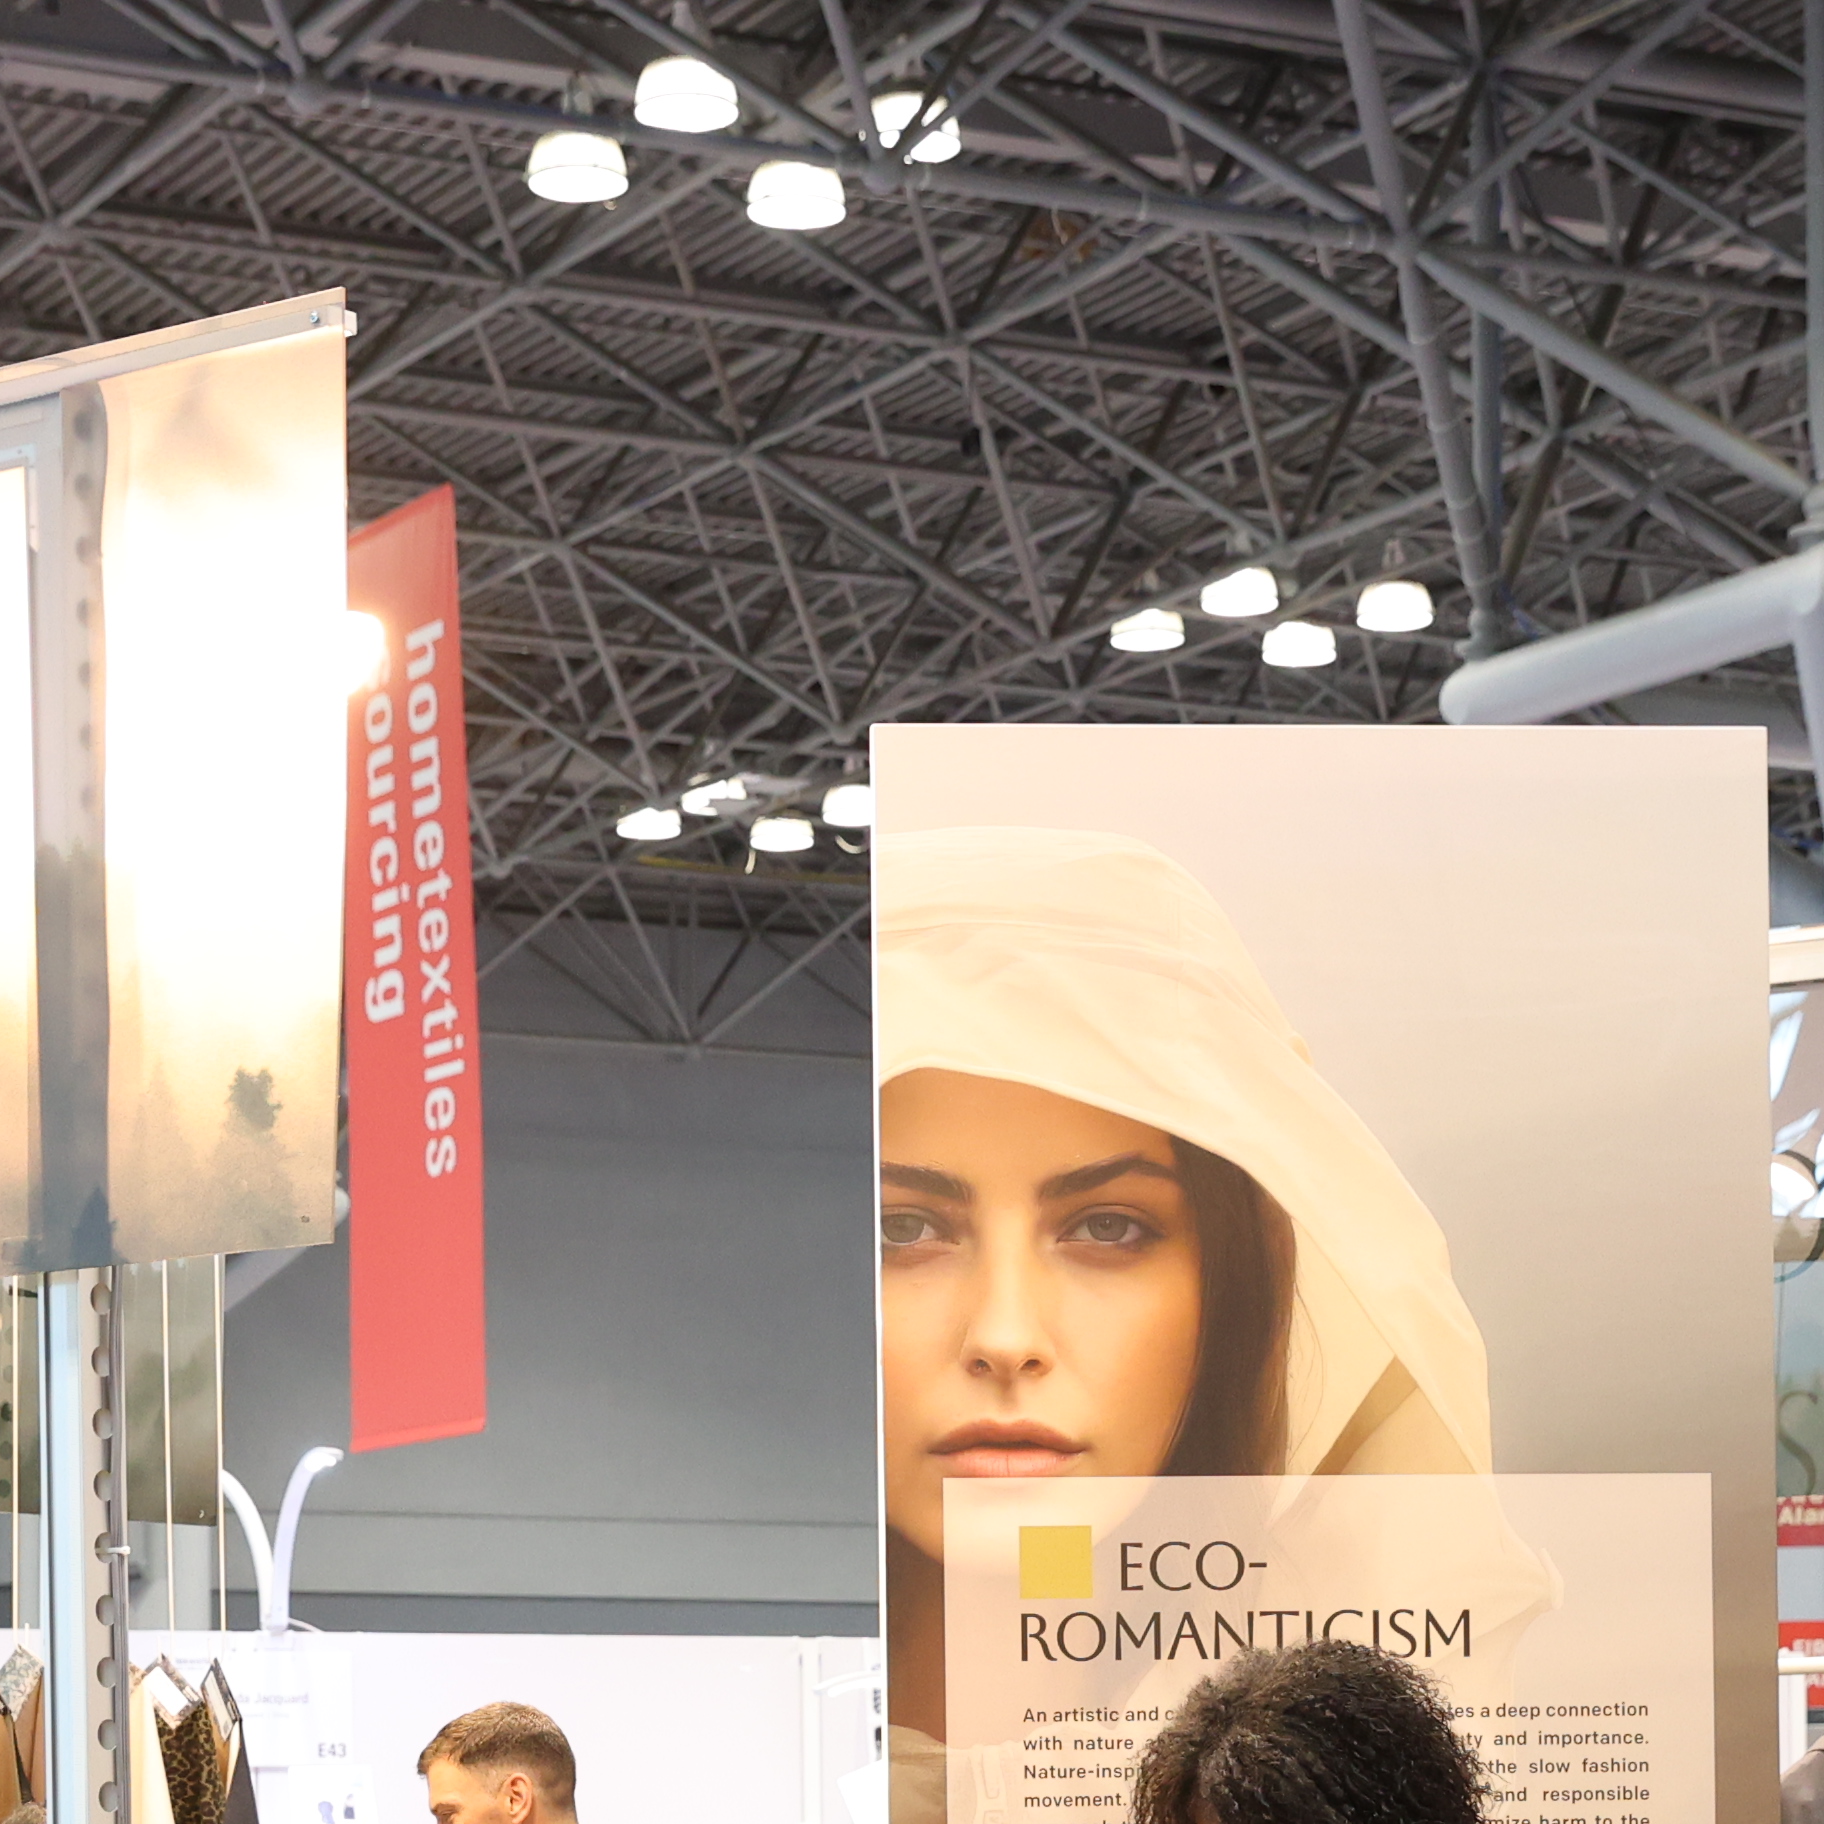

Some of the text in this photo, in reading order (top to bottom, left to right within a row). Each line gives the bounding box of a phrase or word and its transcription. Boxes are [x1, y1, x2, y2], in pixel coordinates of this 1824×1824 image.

[362, 652, 410, 1024] ourcing
[405, 619, 465, 1178] hometextiles
[1120, 1540, 1268, 1591] ECO-
[1020, 1608, 1471, 1661] ROMANTICISM
[1023, 1708, 1046, 1722] An
[1053, 1707, 1120, 1722] artistic
[1126, 1706, 1160, 1721] and
[1480, 1706, 1490, 1718] a
[1496, 1702, 1541, 1720] deep
[1546, 1701, 1649, 1717] connection
[317, 1742, 347, 1758] E43
[1023, 1736, 1063, 1750] with
[1073, 1737, 1134, 1750] nature
[1493, 1730, 1528, 1746] and
[1538, 1730, 1649, 1748] importance.
[1024, 1757, 1649, 1781] Nature-insp the slow fashion
[1024, 1785, 1650, 1807] movement. and responsible
